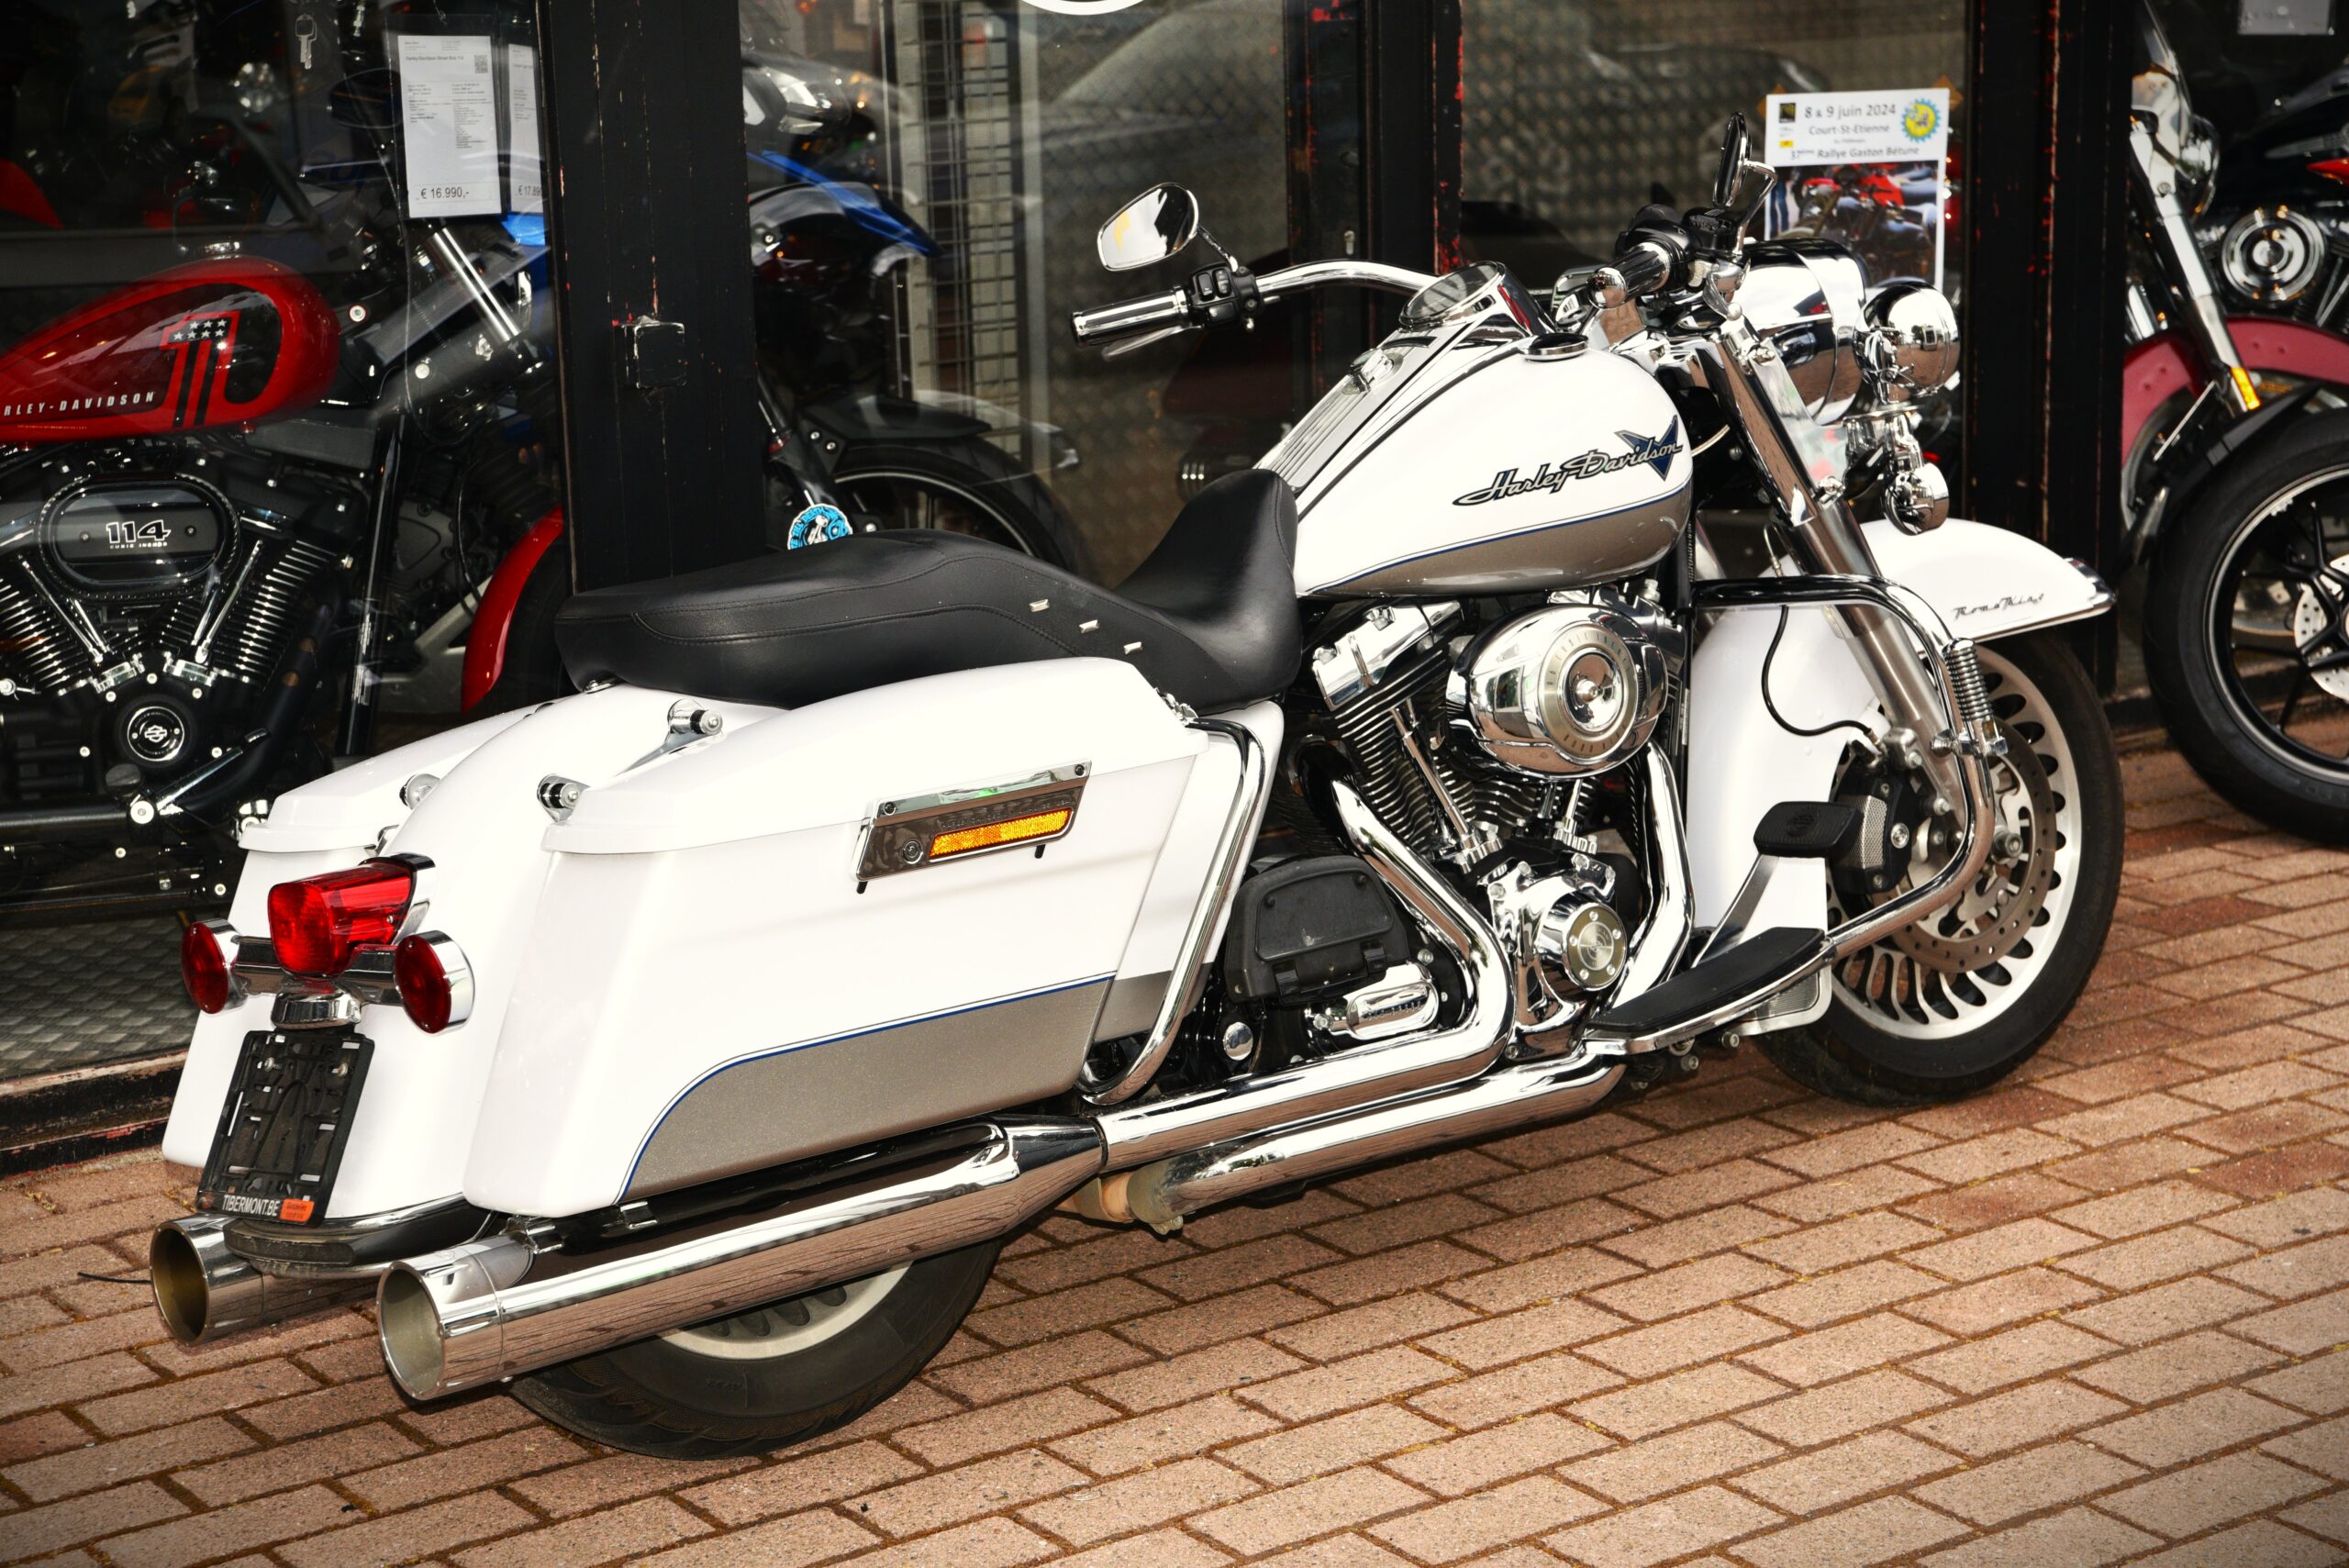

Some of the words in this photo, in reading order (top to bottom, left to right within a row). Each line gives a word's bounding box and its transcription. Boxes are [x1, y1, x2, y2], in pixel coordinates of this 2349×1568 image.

[1805, 106, 1813, 118] 8
[1826, 106, 1835, 117] 9
[1838, 105, 1863, 120] juin
[1865, 104, 1897, 117] 2024
[1817, 147, 1847, 159] Rallye
[1850, 146, 1884, 158] Gaston
[420, 187, 428, 200] €
[430, 186, 470, 199] 16.990,-
[4, 391, 155, 417] RLEY-DAVIDSON
[1452, 437, 1684, 506] Harley-Davidson
[106, 518, 172, 544] 114
[221, 1194, 281, 1217] TIBERMONT.BE
